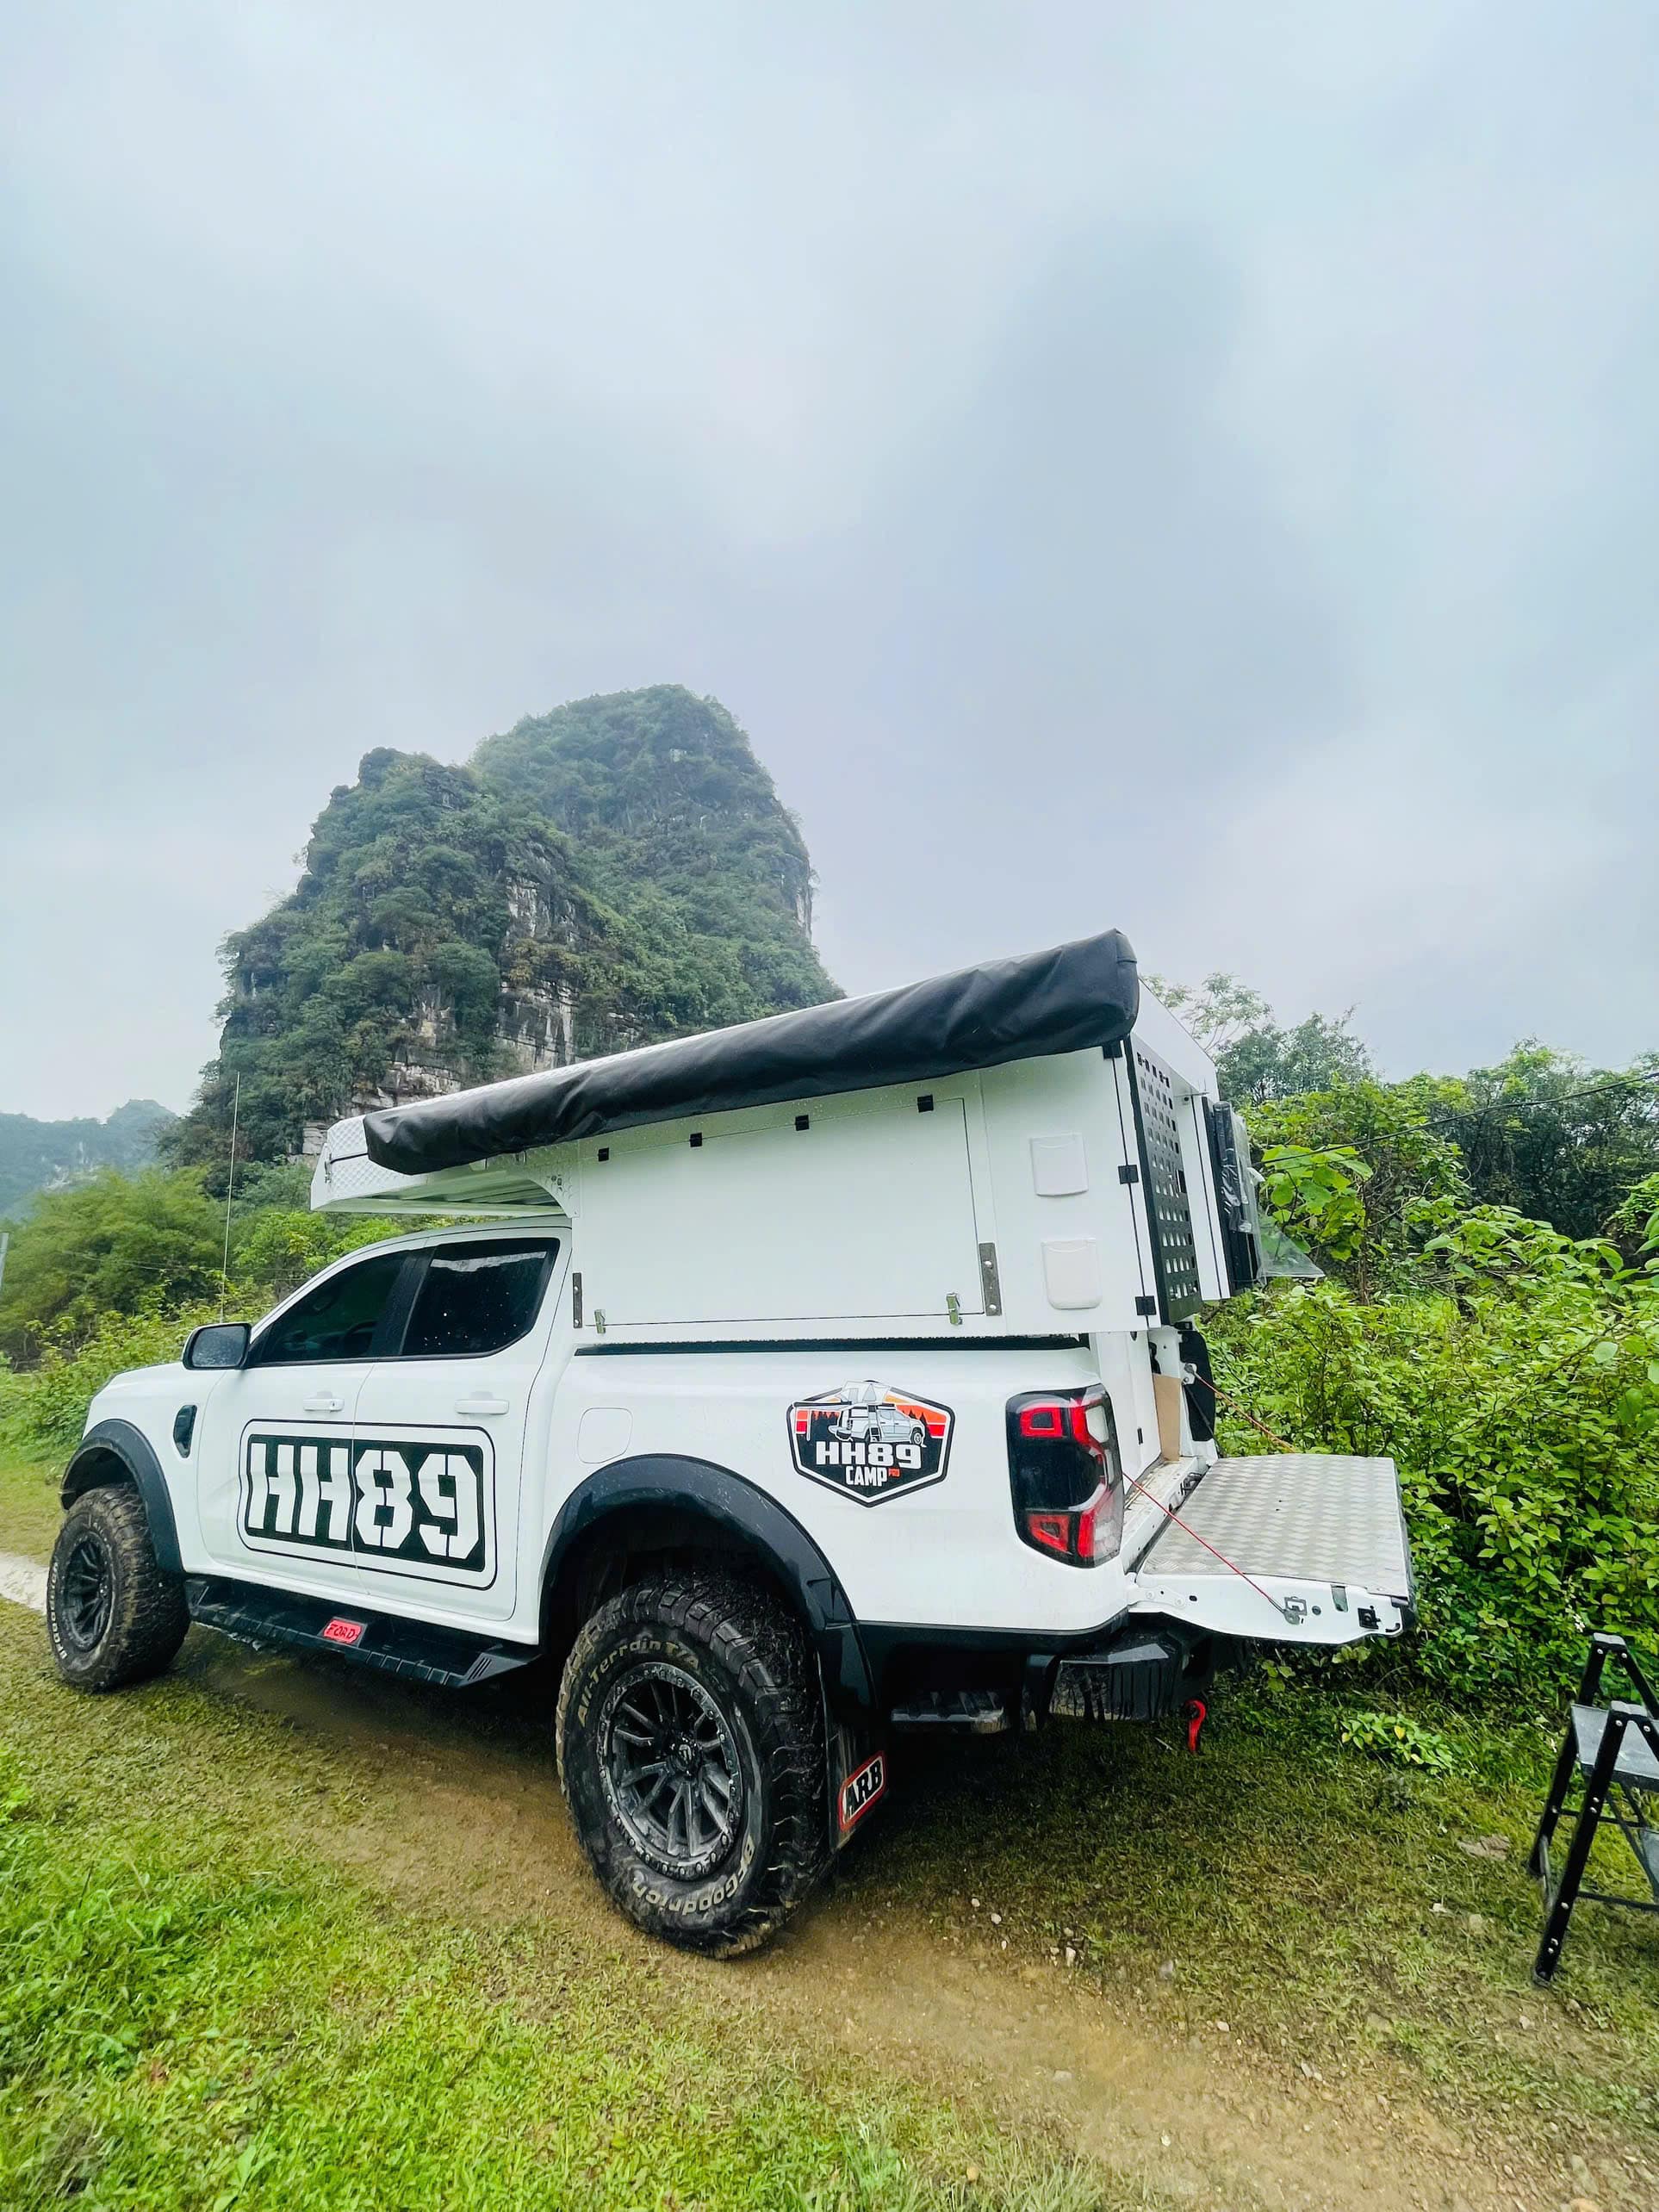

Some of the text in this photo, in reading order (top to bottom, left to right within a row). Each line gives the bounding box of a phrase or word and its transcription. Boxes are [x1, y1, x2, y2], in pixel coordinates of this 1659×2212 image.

[816, 1441, 922, 1469] HH89
[846, 1466, 887, 1487] CAMP
[248, 1442, 481, 1560] HH89
[326, 1623, 357, 1639] FORD
[578, 1638, 662, 1728] All-Terrain
[846, 1759, 882, 1820] ARB
[632, 1834, 755, 1917] BFGoodrich
